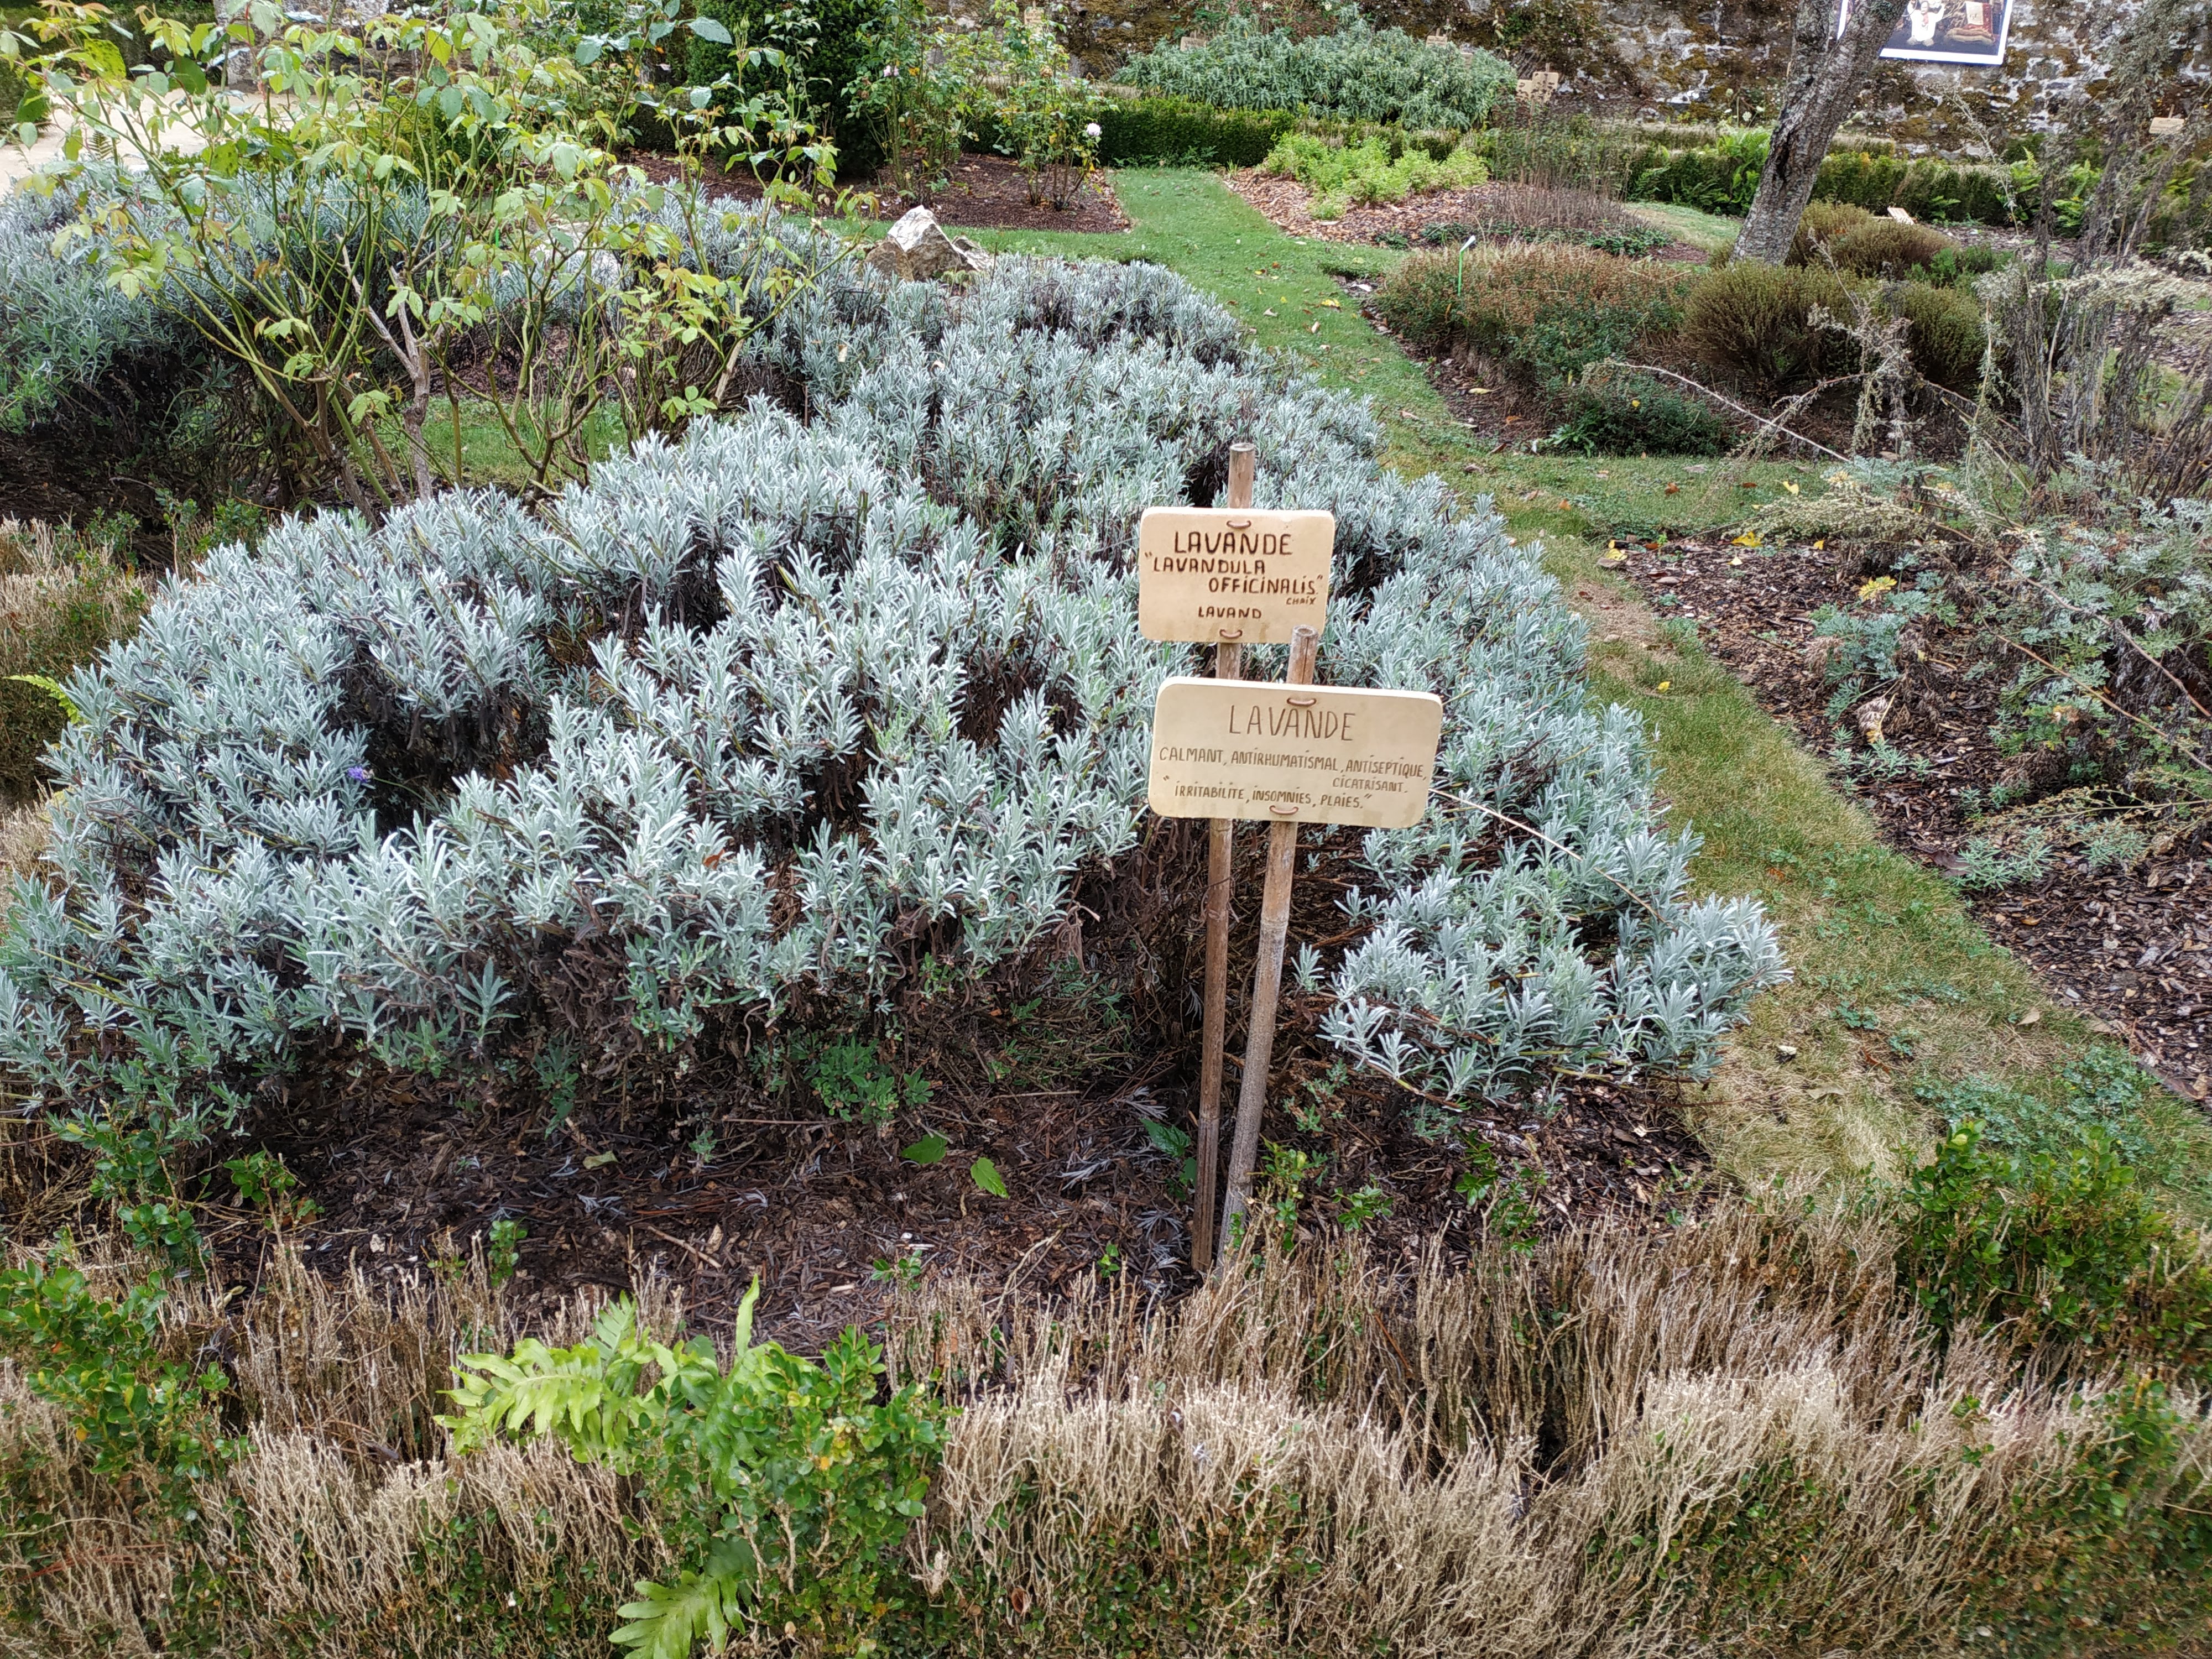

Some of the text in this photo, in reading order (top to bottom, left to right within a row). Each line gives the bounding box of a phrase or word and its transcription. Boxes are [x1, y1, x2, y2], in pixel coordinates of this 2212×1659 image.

[1174, 531, 1293, 556] LAVANDE
[1198, 606, 1262, 619] LAVAND
[1286, 596, 1317, 606] CHAIX
[1229, 705, 1357, 742] LAVANDE
[1159, 747, 1228, 766] CALMANT,
[1345, 755, 1427, 781] ANTISEPTIQUE,
[1332, 775, 1408, 794] CICATRISANT.
[1252, 785, 1317, 808] INSOMNIES,
